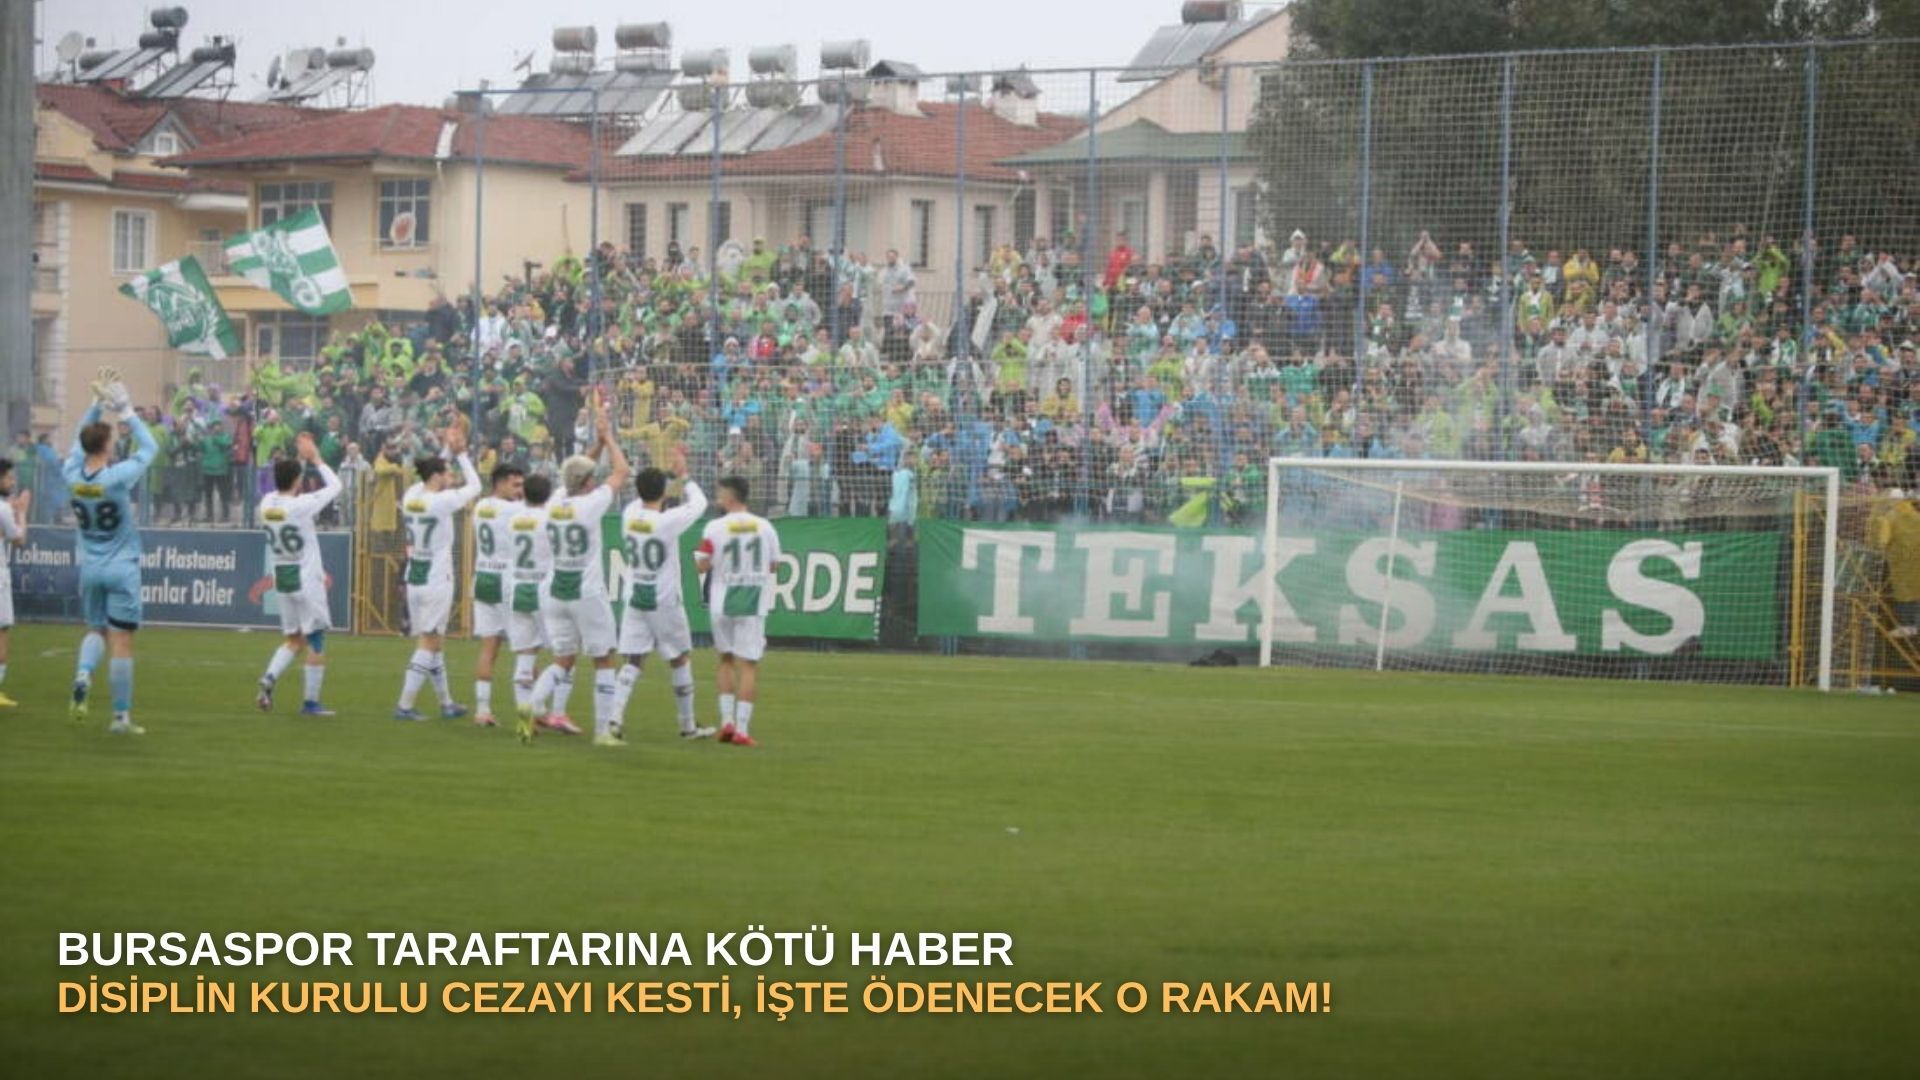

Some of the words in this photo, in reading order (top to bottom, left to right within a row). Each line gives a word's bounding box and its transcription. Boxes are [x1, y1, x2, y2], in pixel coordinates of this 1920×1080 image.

[478, 522, 496, 557] 9
[514, 533, 536, 569] 2
[723, 536, 762, 573] 11
[164, 546, 236, 571] Hastanesi
[192, 578, 235, 606] Diler
[768, 551, 878, 613] RDE
[961, 527, 1706, 656] TEKSAS
